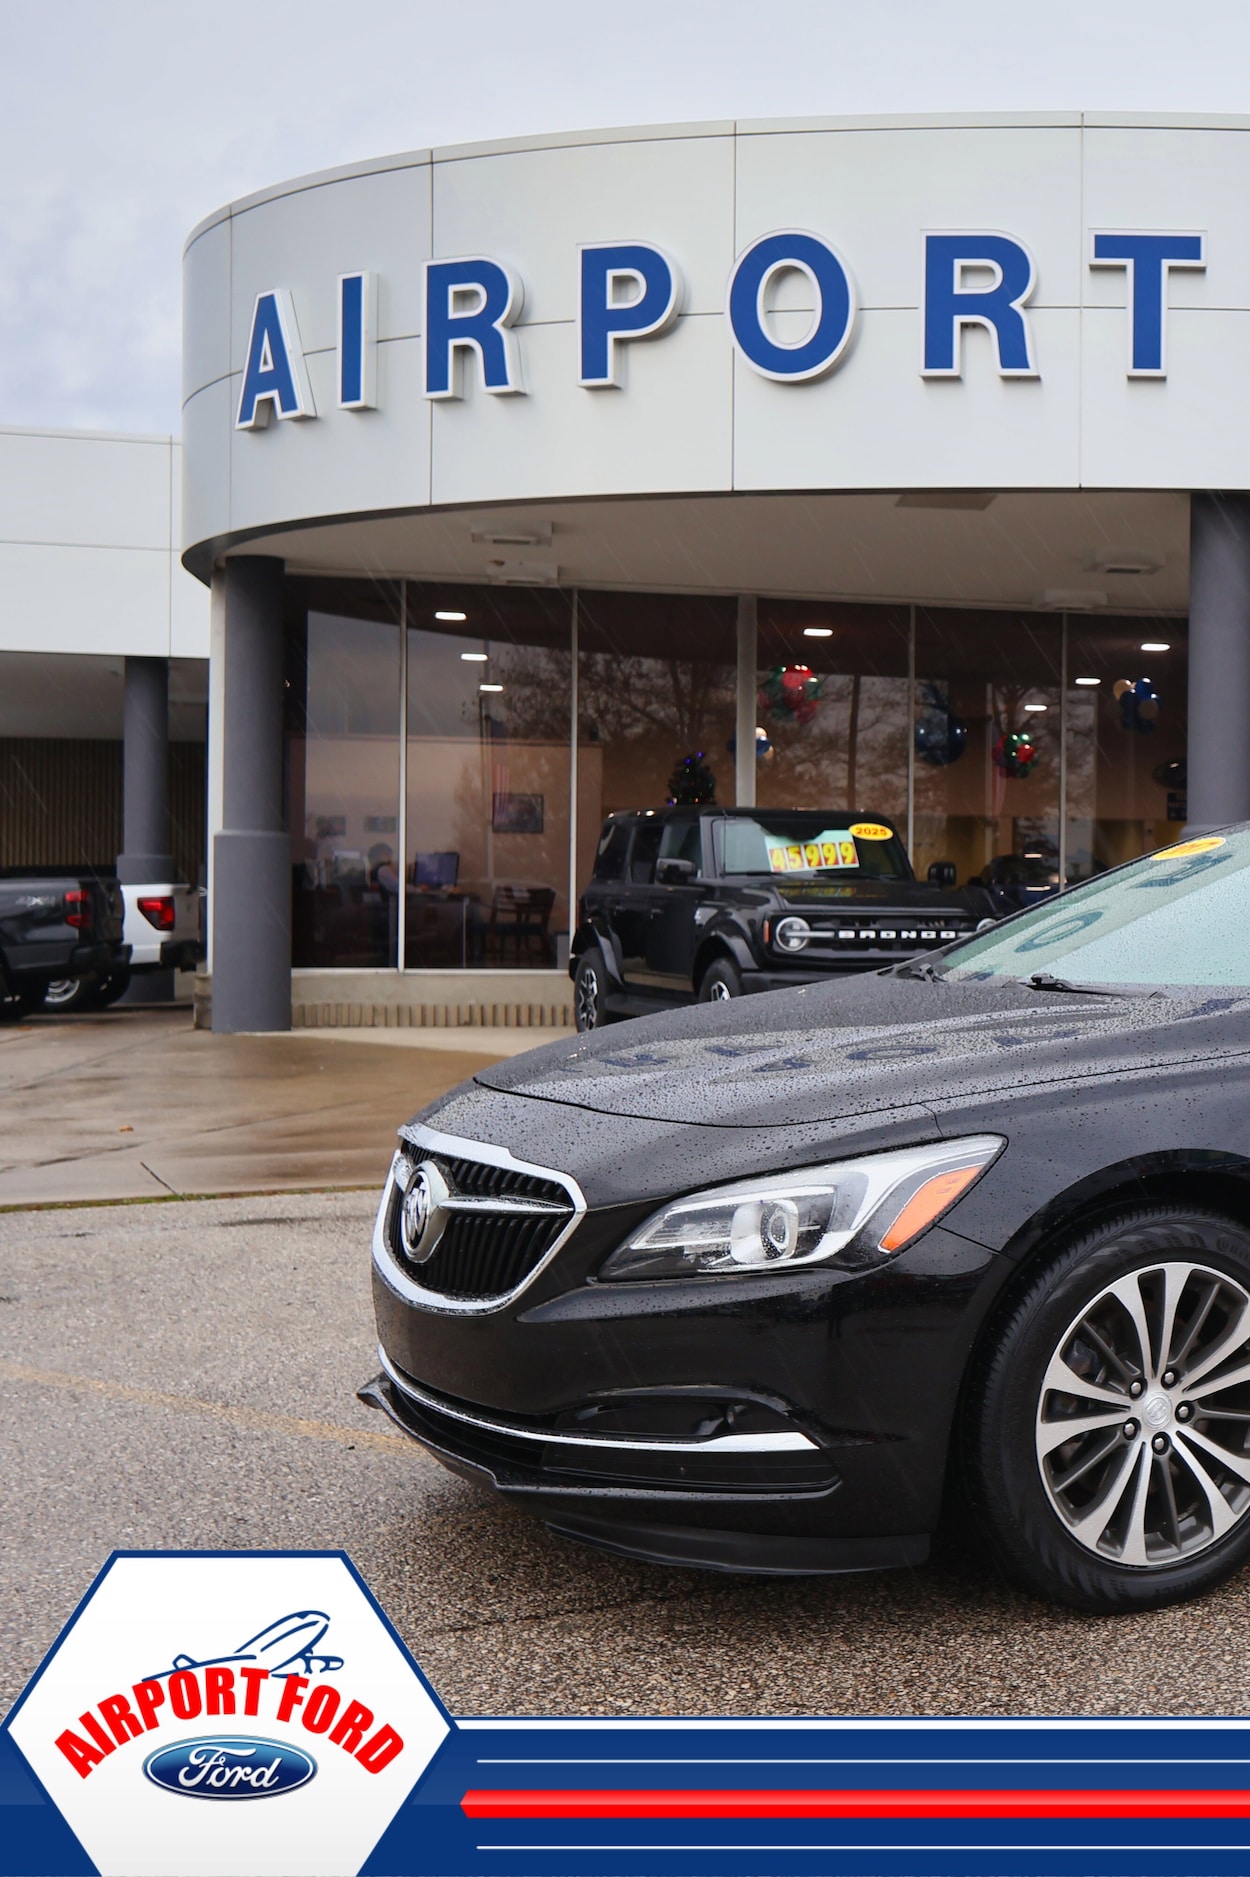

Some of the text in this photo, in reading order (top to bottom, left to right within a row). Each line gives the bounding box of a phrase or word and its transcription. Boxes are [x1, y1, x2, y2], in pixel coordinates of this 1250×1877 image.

[235, 228, 1207, 432] AIRPORT
[855, 827, 888, 836] 2025
[770, 841, 858, 871] 45999
[838, 930, 956, 939] BRONCO
